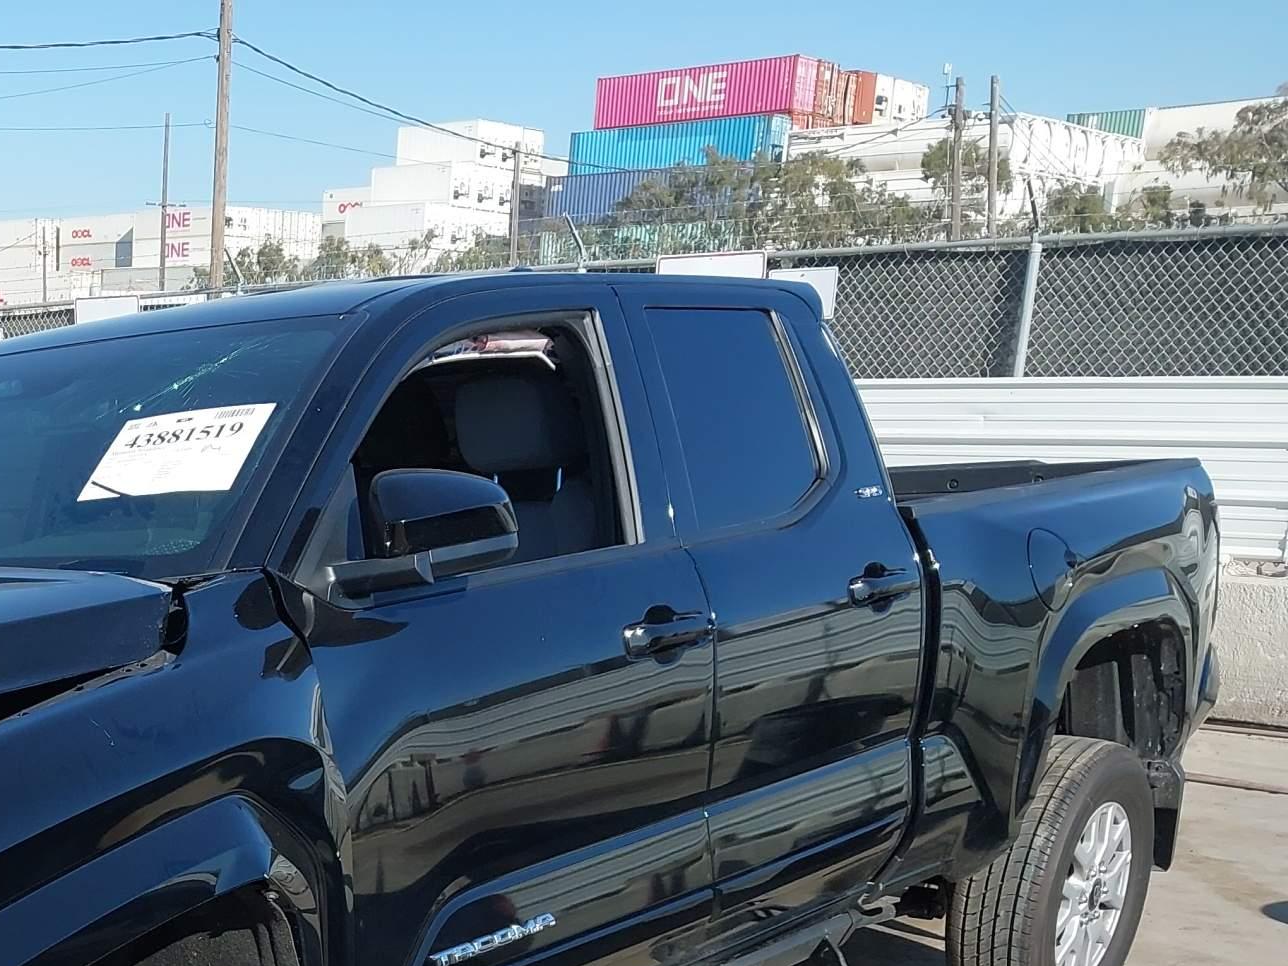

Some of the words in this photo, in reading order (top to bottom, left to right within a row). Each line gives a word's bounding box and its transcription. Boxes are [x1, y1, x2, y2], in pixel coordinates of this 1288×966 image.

[657, 71, 727, 107] ONE
[71, 228, 92, 239] OOCL
[71, 256, 92, 267] OOCL
[124, 421, 244, 449] 43881519
